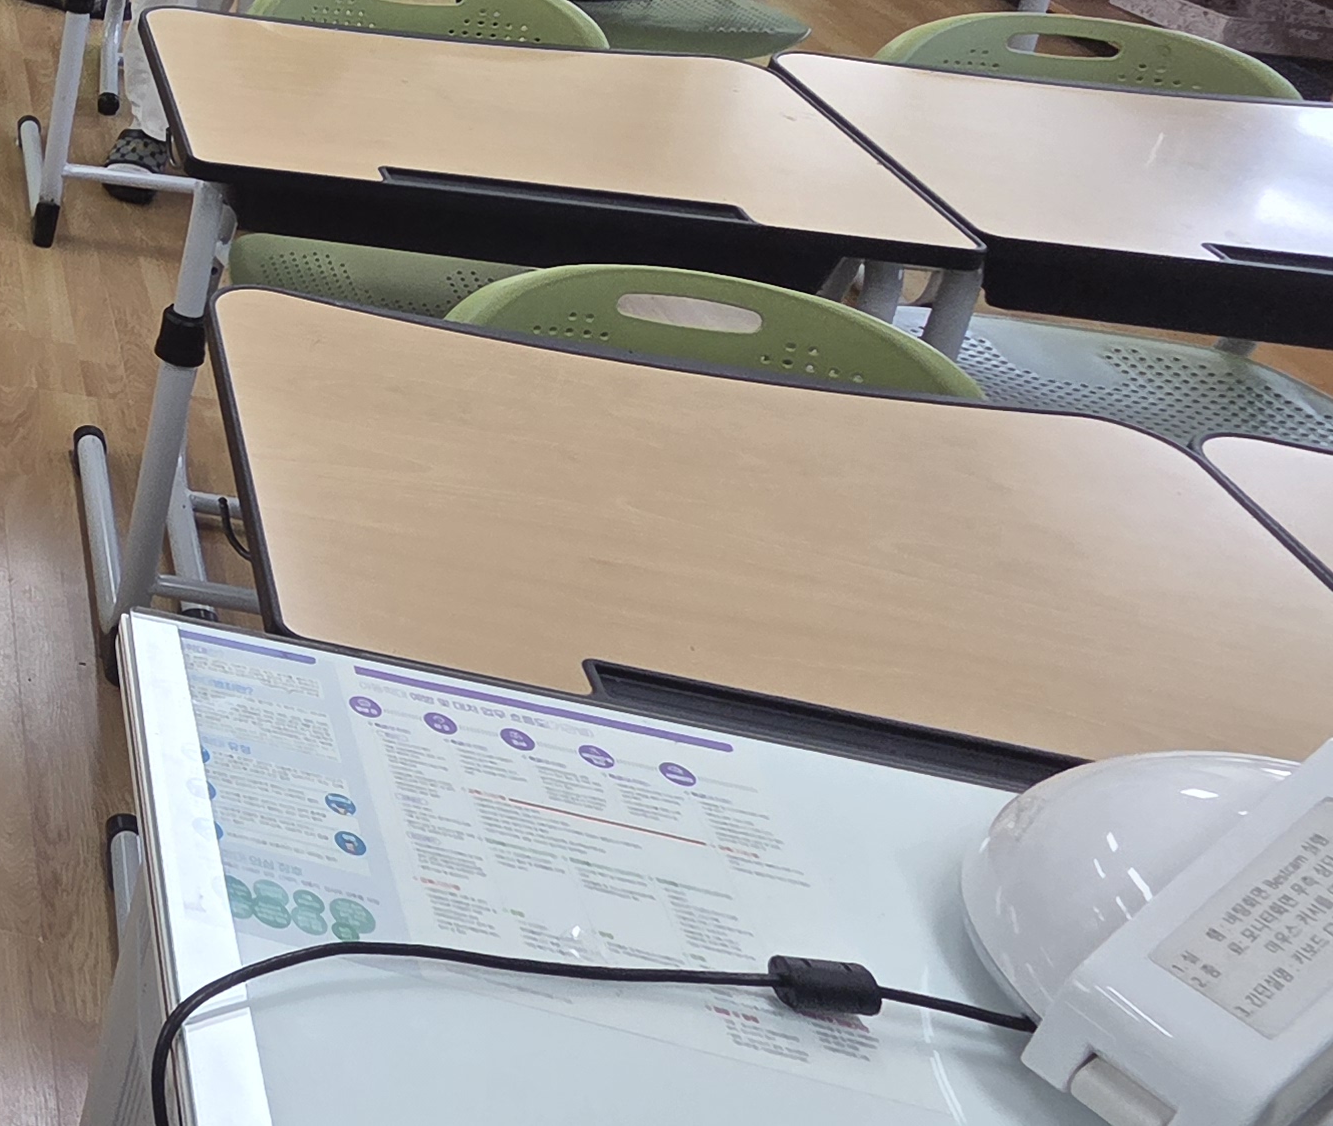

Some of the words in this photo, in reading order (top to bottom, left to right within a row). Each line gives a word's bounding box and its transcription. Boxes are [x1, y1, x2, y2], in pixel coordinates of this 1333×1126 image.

[1222, 886, 1271, 925] 바탕화면
[1300, 832, 1330, 856] 실행
[1240, 893, 1299, 943] 모니터화면
[1264, 924, 1303, 954] 마우스
[1291, 933, 1331, 965] 키보드
